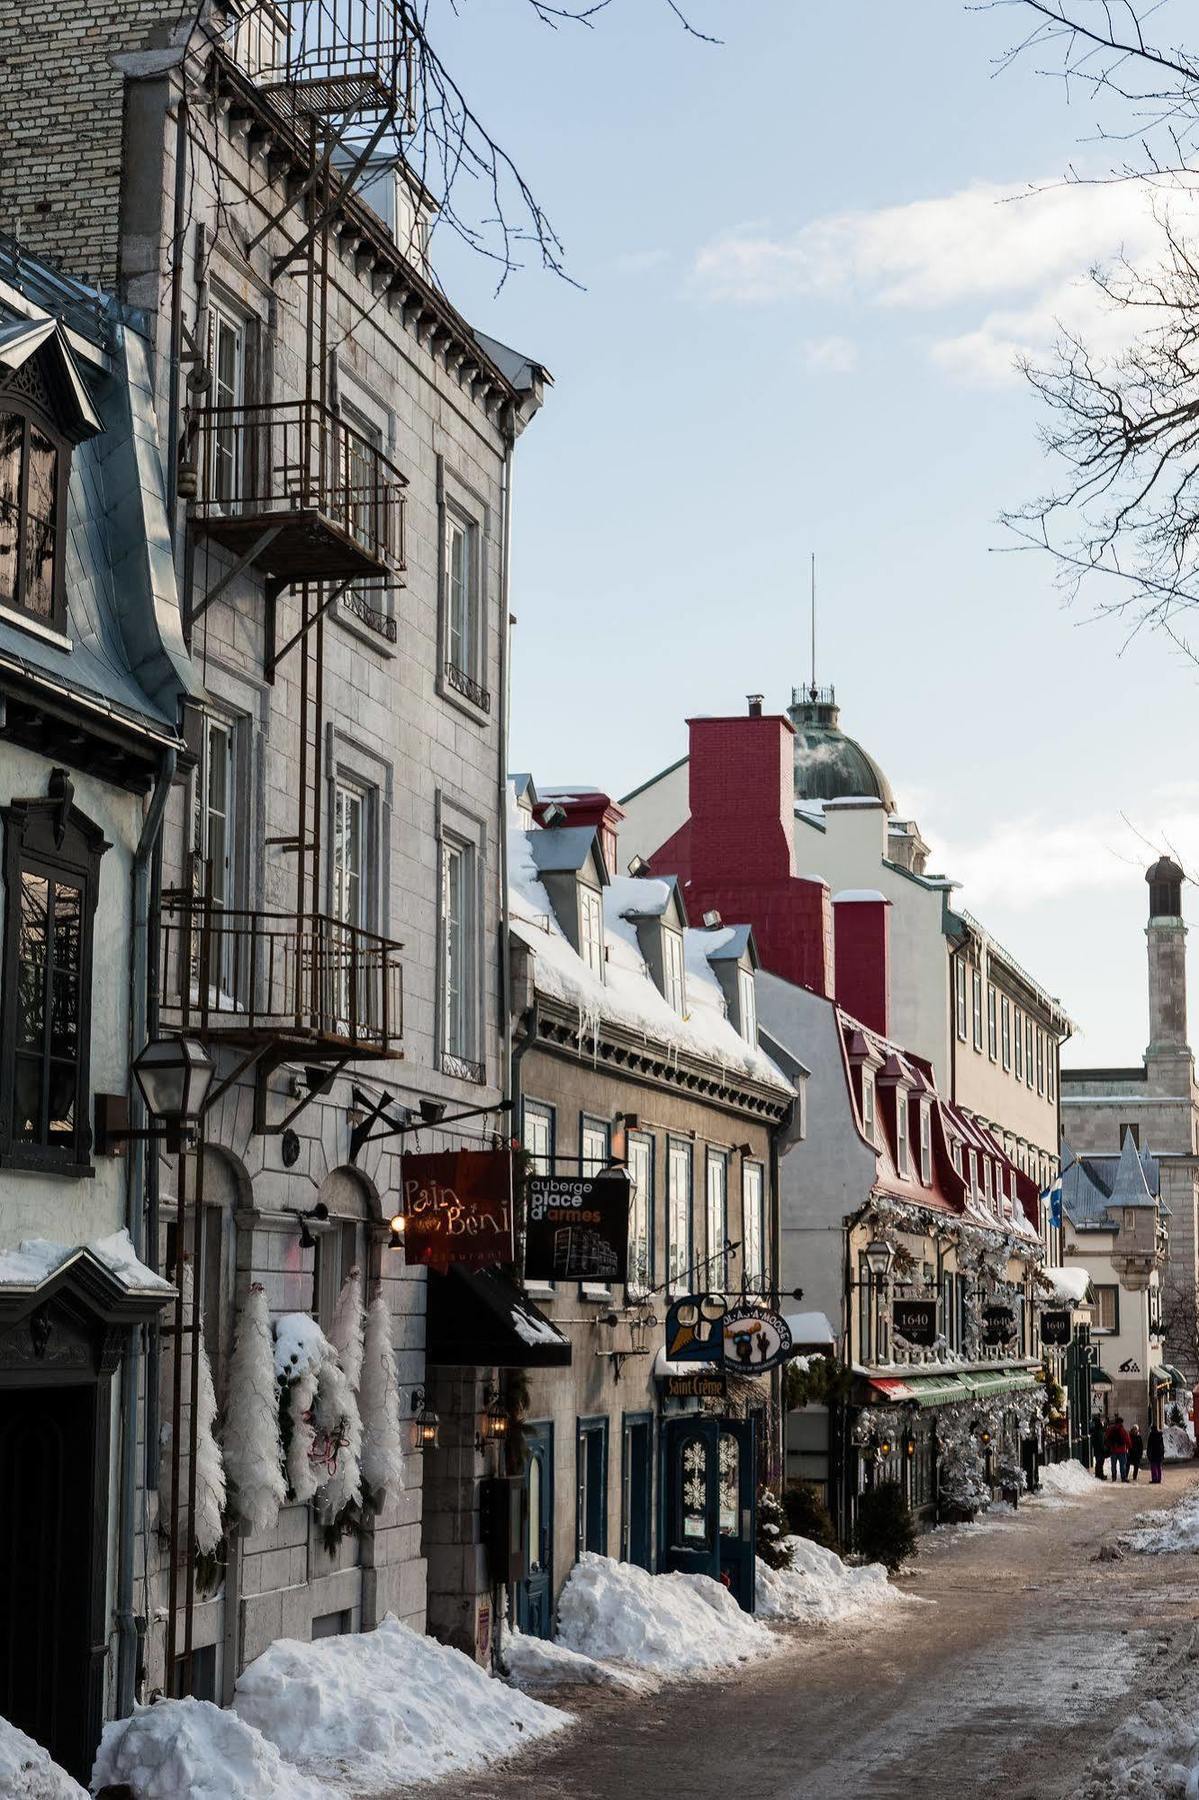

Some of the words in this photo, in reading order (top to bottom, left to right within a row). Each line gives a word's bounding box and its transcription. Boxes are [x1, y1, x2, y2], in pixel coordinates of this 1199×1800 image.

[531, 1180, 593, 1195] auberge
[405, 1180, 465, 1217] Pain
[531, 1191, 583, 1208] place
[531, 1205, 601, 1223] d'armes
[762, 1311, 790, 1341] MOOSE
[902, 1313, 928, 1326] 1640
[1046, 1321, 1065, 1329] 1640
